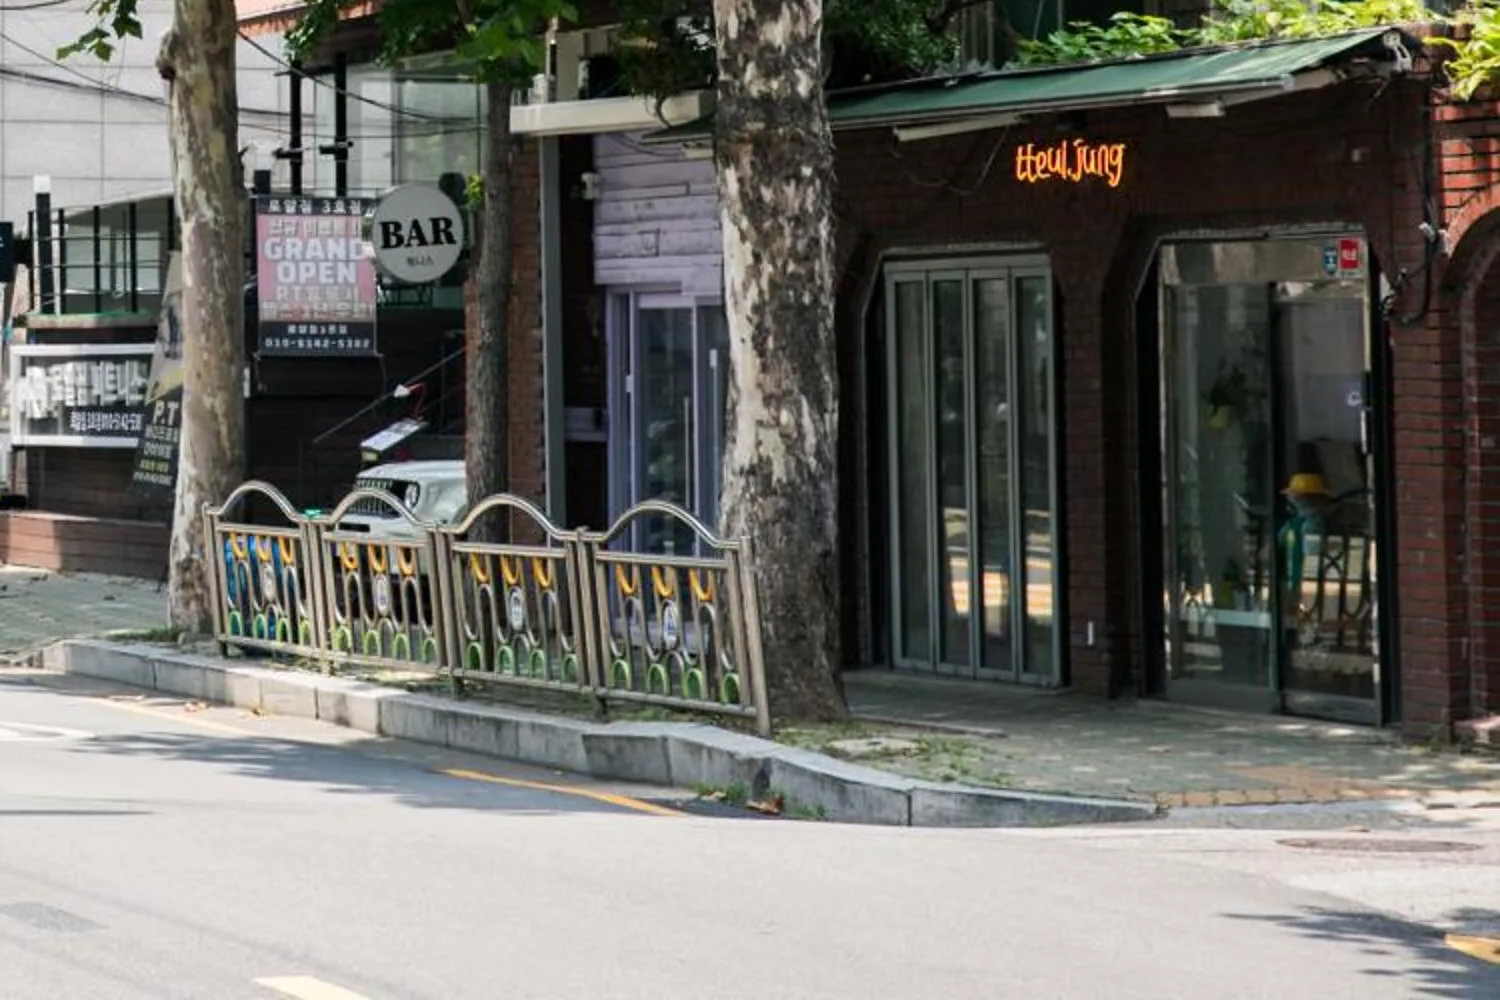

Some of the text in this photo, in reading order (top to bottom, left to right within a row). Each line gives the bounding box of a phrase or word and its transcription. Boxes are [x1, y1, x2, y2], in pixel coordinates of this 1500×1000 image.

[379, 216, 457, 249] BAR
[263, 239, 364, 261] GRAND
[277, 261, 357, 283] OPEN
